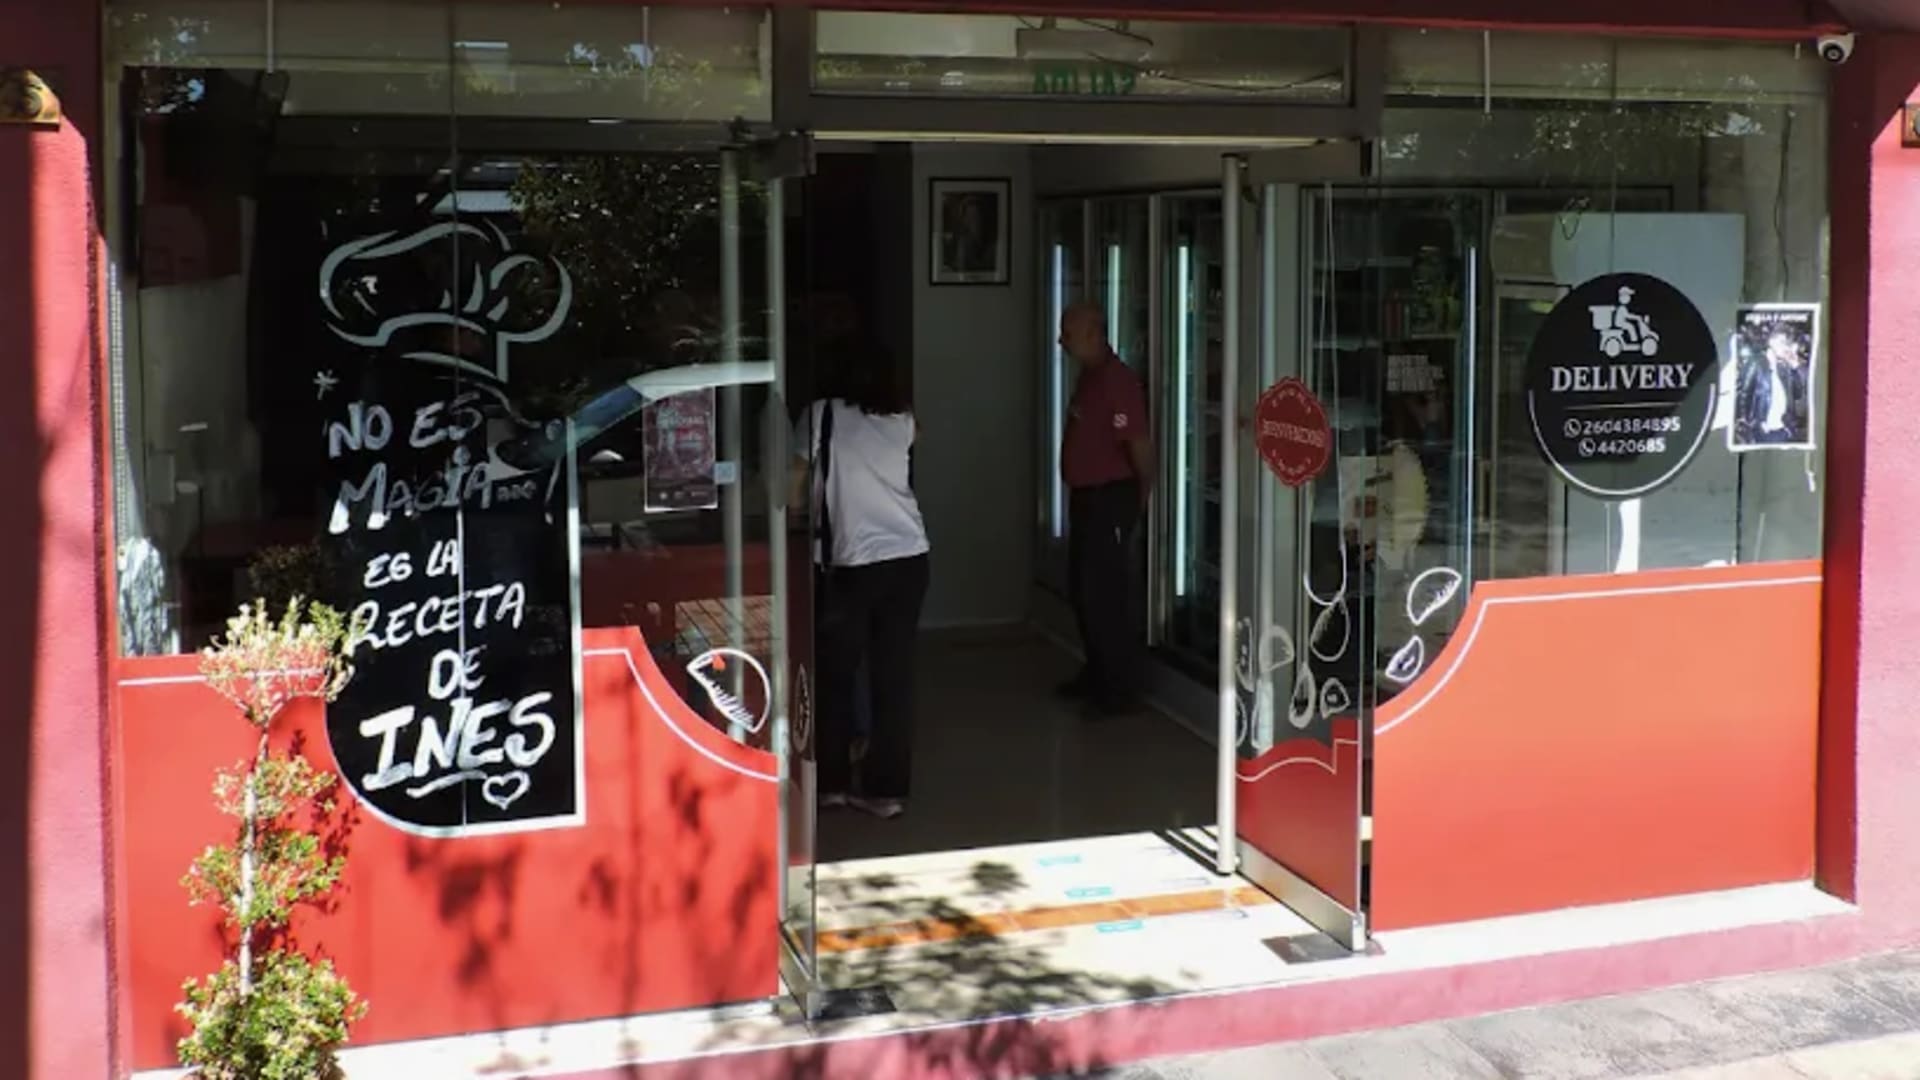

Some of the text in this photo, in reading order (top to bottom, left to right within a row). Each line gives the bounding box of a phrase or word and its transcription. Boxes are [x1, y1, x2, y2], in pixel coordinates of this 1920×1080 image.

[1551, 363, 1694, 392] DELIVERY
[328, 391, 482, 459] NO ES
[1583, 416, 1682, 436] 2604384895
[1598, 437, 1667, 455] 4420685
[363, 538, 460, 589] ES LA
[346, 581, 526, 655] RECETA
[428, 644, 488, 699] DE
[359, 691, 556, 791] INES
